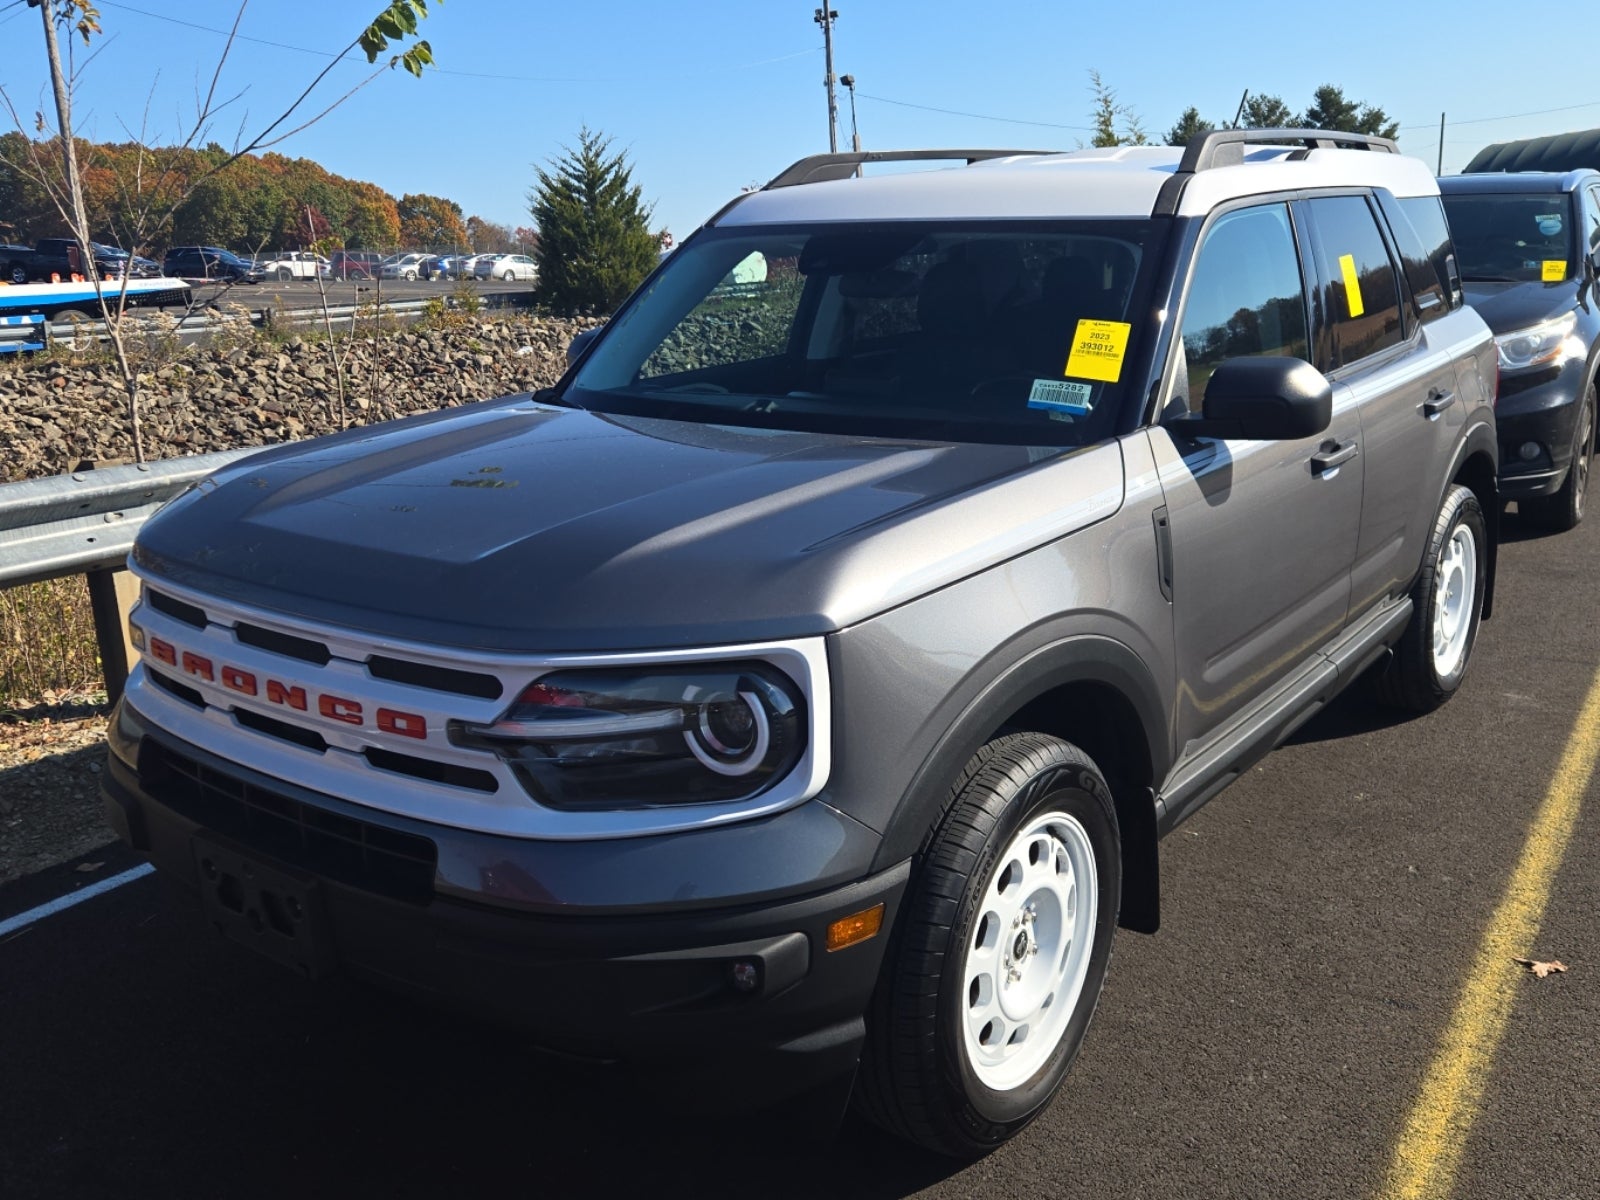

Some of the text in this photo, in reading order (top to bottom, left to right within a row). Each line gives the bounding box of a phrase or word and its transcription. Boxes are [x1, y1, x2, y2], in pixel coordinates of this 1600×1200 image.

[1089, 332, 1110, 340] 2023
[1080, 342, 1114, 352] 393012
[150, 636, 427, 740] BRONCO
